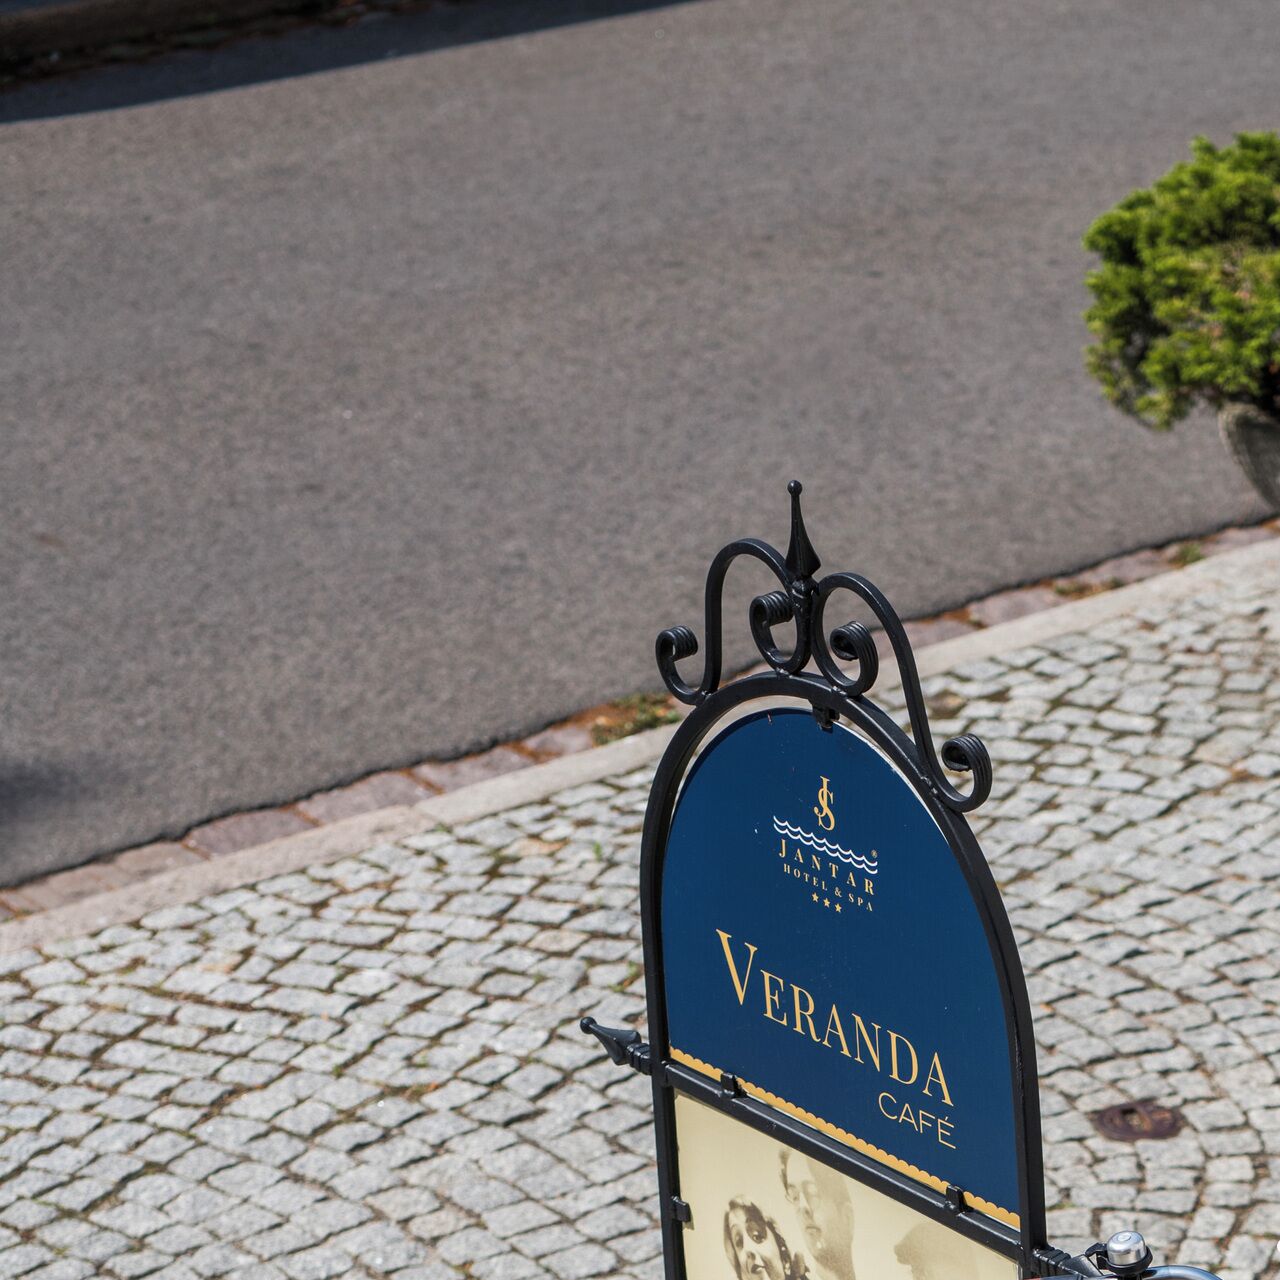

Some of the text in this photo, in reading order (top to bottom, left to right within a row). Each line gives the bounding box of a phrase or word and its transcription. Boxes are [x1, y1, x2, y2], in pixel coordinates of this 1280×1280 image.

[779, 838, 874, 896] JANTAR
[783, 863, 873, 912] HOTEL & SPA
[715, 928, 954, 1107] VERANDA
[878, 1092, 956, 1149] CAFÉ
